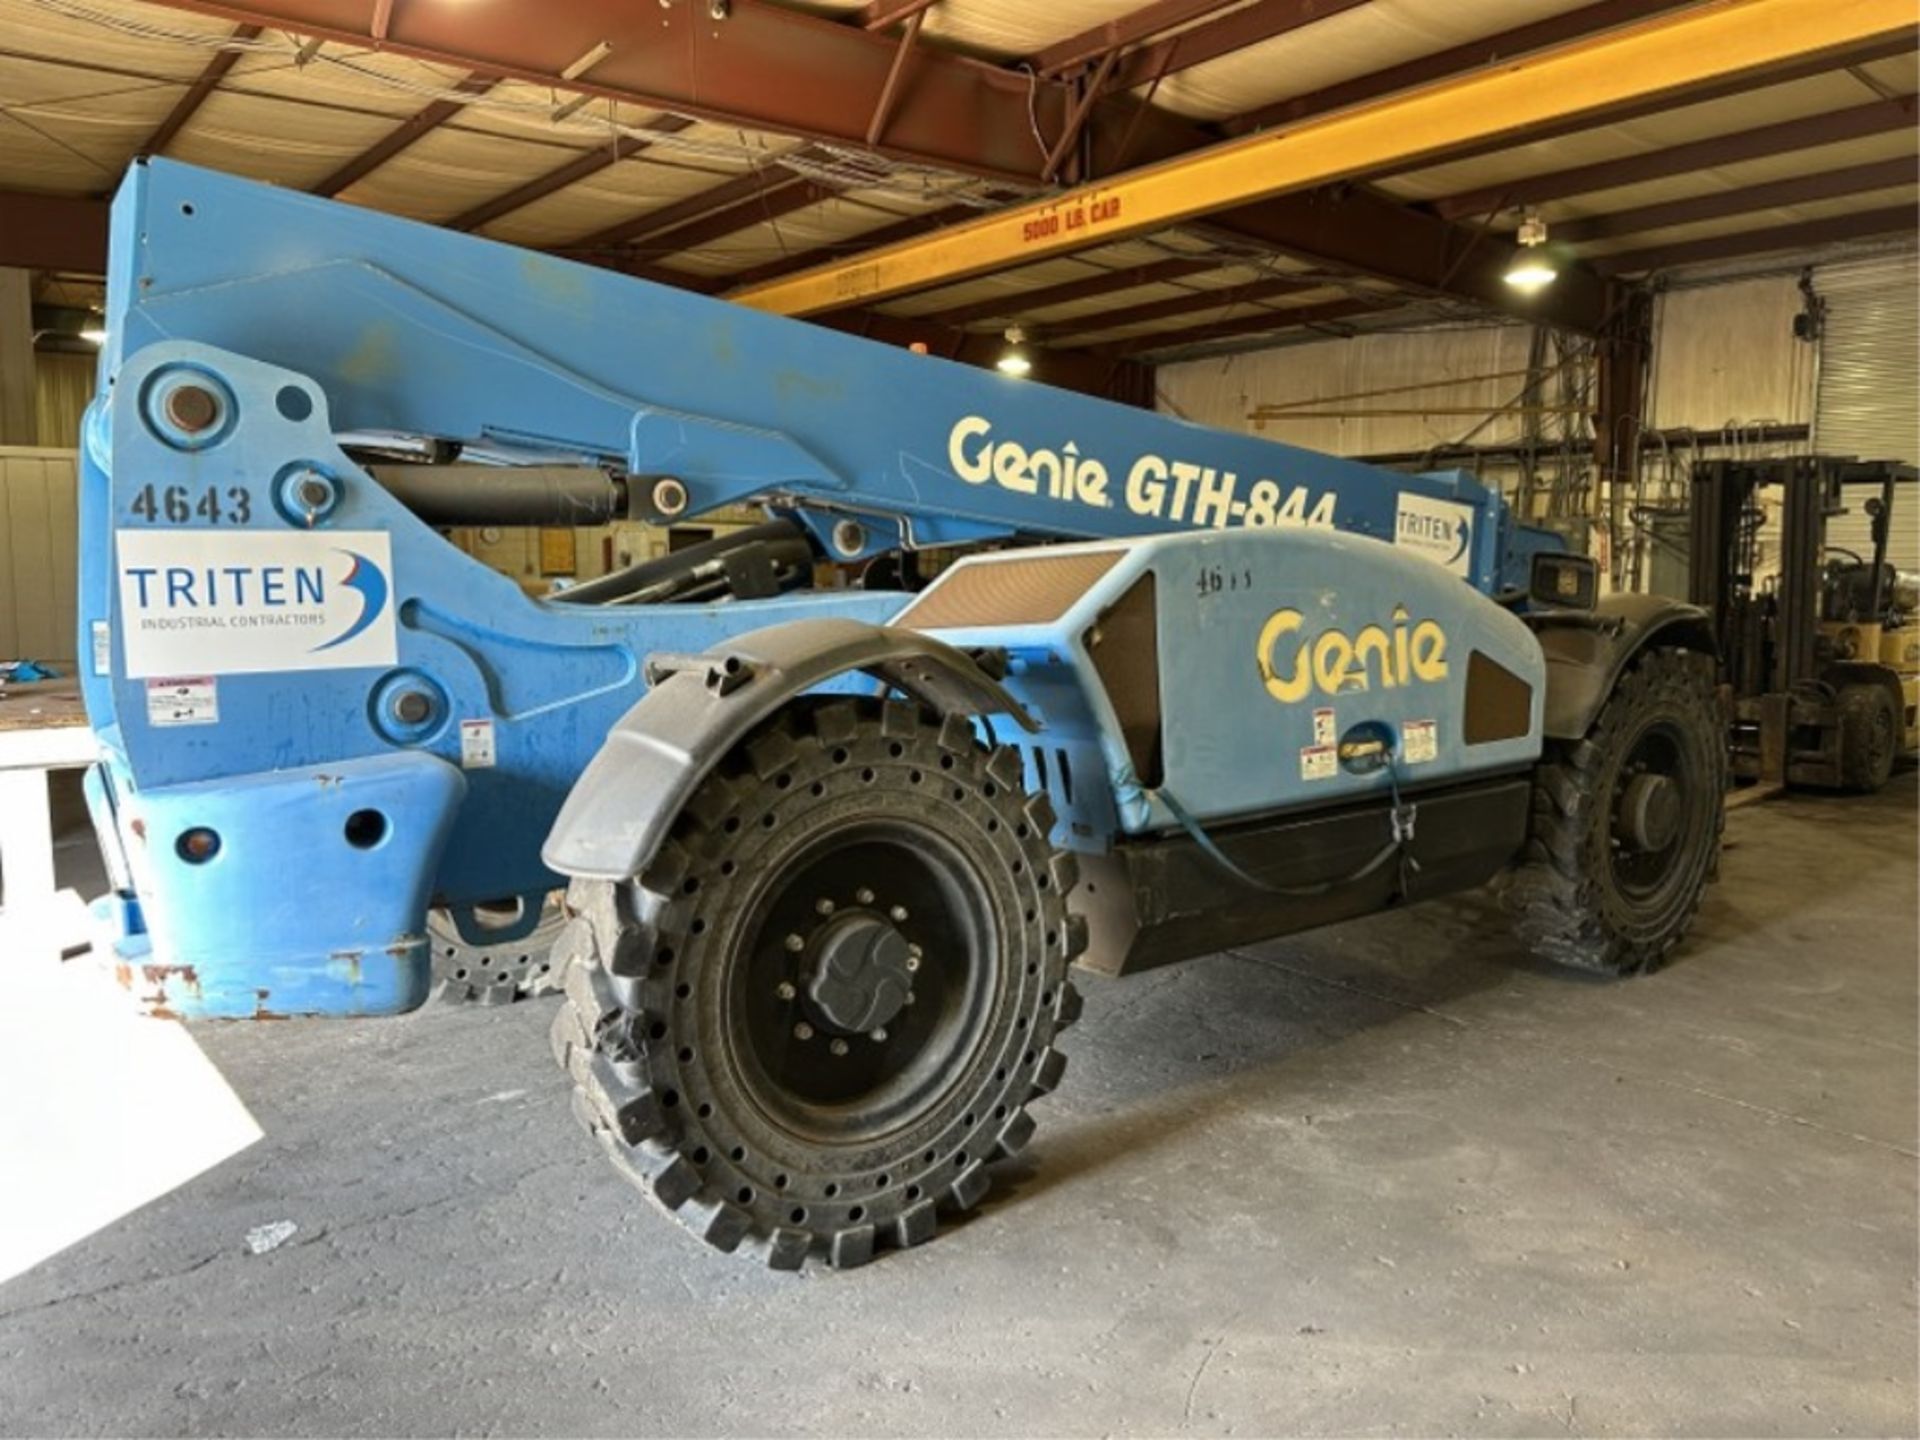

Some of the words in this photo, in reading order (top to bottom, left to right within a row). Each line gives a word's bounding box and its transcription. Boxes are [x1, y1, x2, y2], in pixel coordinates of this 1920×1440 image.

[1024, 215, 1058, 242] 5000
[949, 416, 1109, 507] Genie
[1125, 454, 1337, 531] GTH-844
[131, 483, 251, 524] 4643
[1400, 512, 1452, 541] TRITEN
[125, 567, 325, 608] TRITEN
[141, 614, 226, 631] INDUSTRIAL
[230, 612, 326, 628] CONTRACTORS
[1257, 604, 1448, 704] Genie
